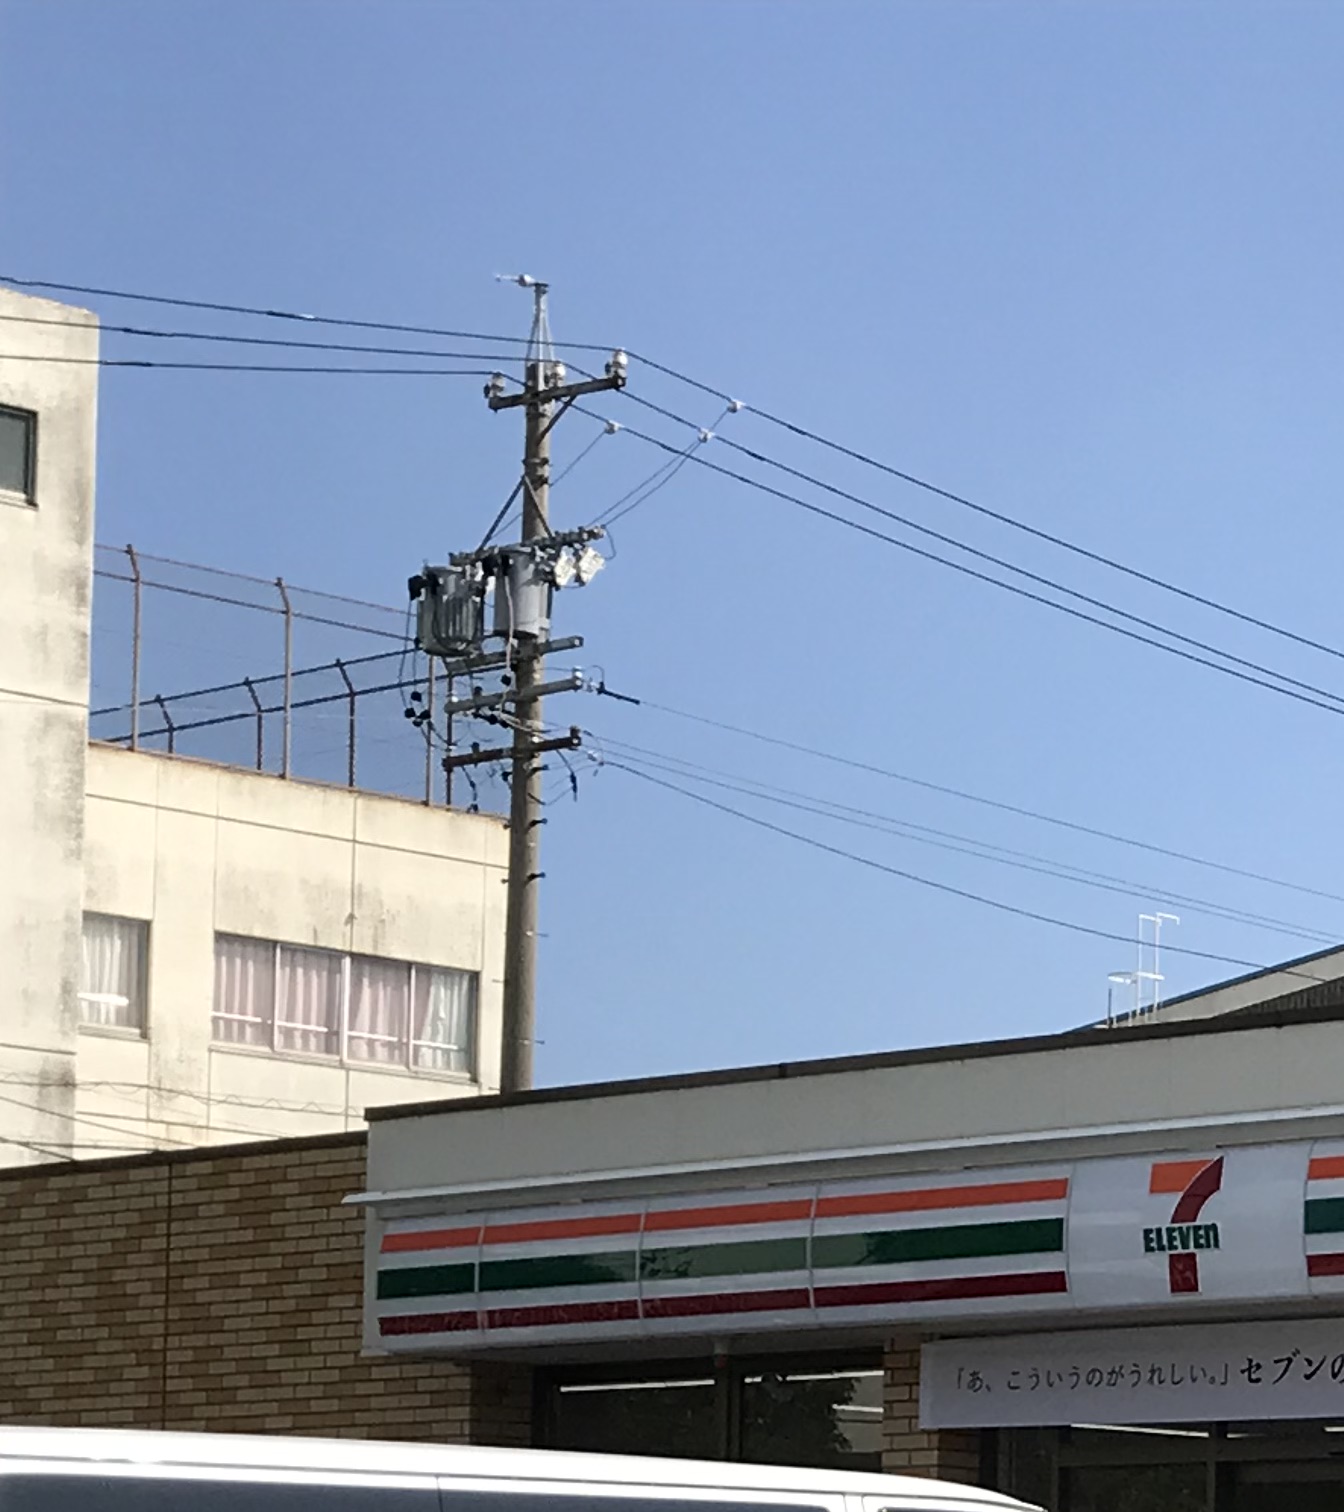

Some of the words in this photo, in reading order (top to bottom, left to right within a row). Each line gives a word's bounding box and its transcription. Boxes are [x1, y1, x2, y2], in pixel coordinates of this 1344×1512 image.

[1143, 1222, 1220, 1253] ELEVEN
[1148, 1154, 1225, 1294] 7
[956, 1362, 1230, 1393] 「あ、こういうのがうれしい。」
